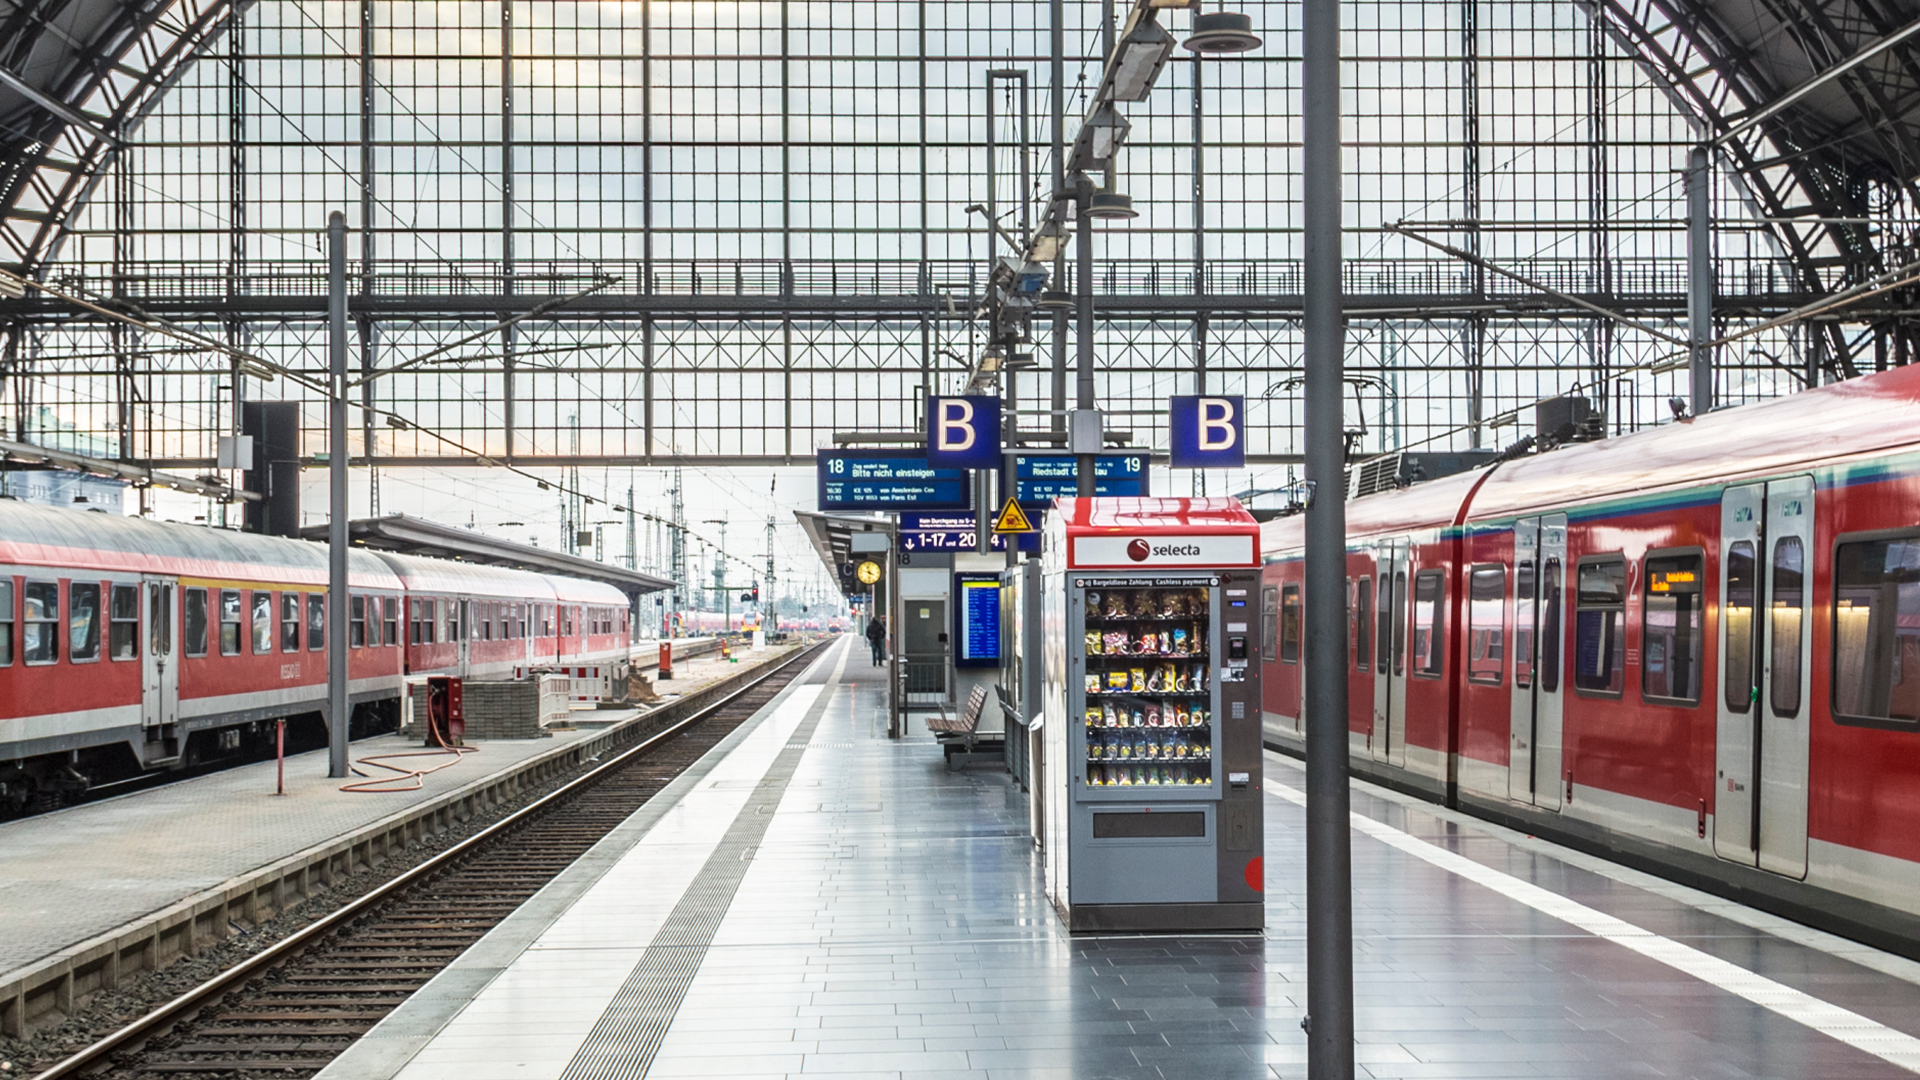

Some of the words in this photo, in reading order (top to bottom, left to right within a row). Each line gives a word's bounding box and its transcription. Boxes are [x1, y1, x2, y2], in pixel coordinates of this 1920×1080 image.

[938, 398, 976, 451] B
[1199, 398, 1236, 450] B
[827, 459, 844, 474] 18
[1032, 467, 1069, 476] Riedstadt
[1124, 457, 1141, 472] 19
[852, 469, 871, 477] Bitte
[874, 469, 893, 477] nicht
[896, 469, 935, 479] einsteigen
[931, 517, 958, 525] Durchgang
[918, 533, 946, 547] 1-17
[1152, 544, 1201, 556] selecta
[843, 564, 853, 576] C
[1630, 561, 1638, 600] 2
[103, 593, 109, 614] 2
